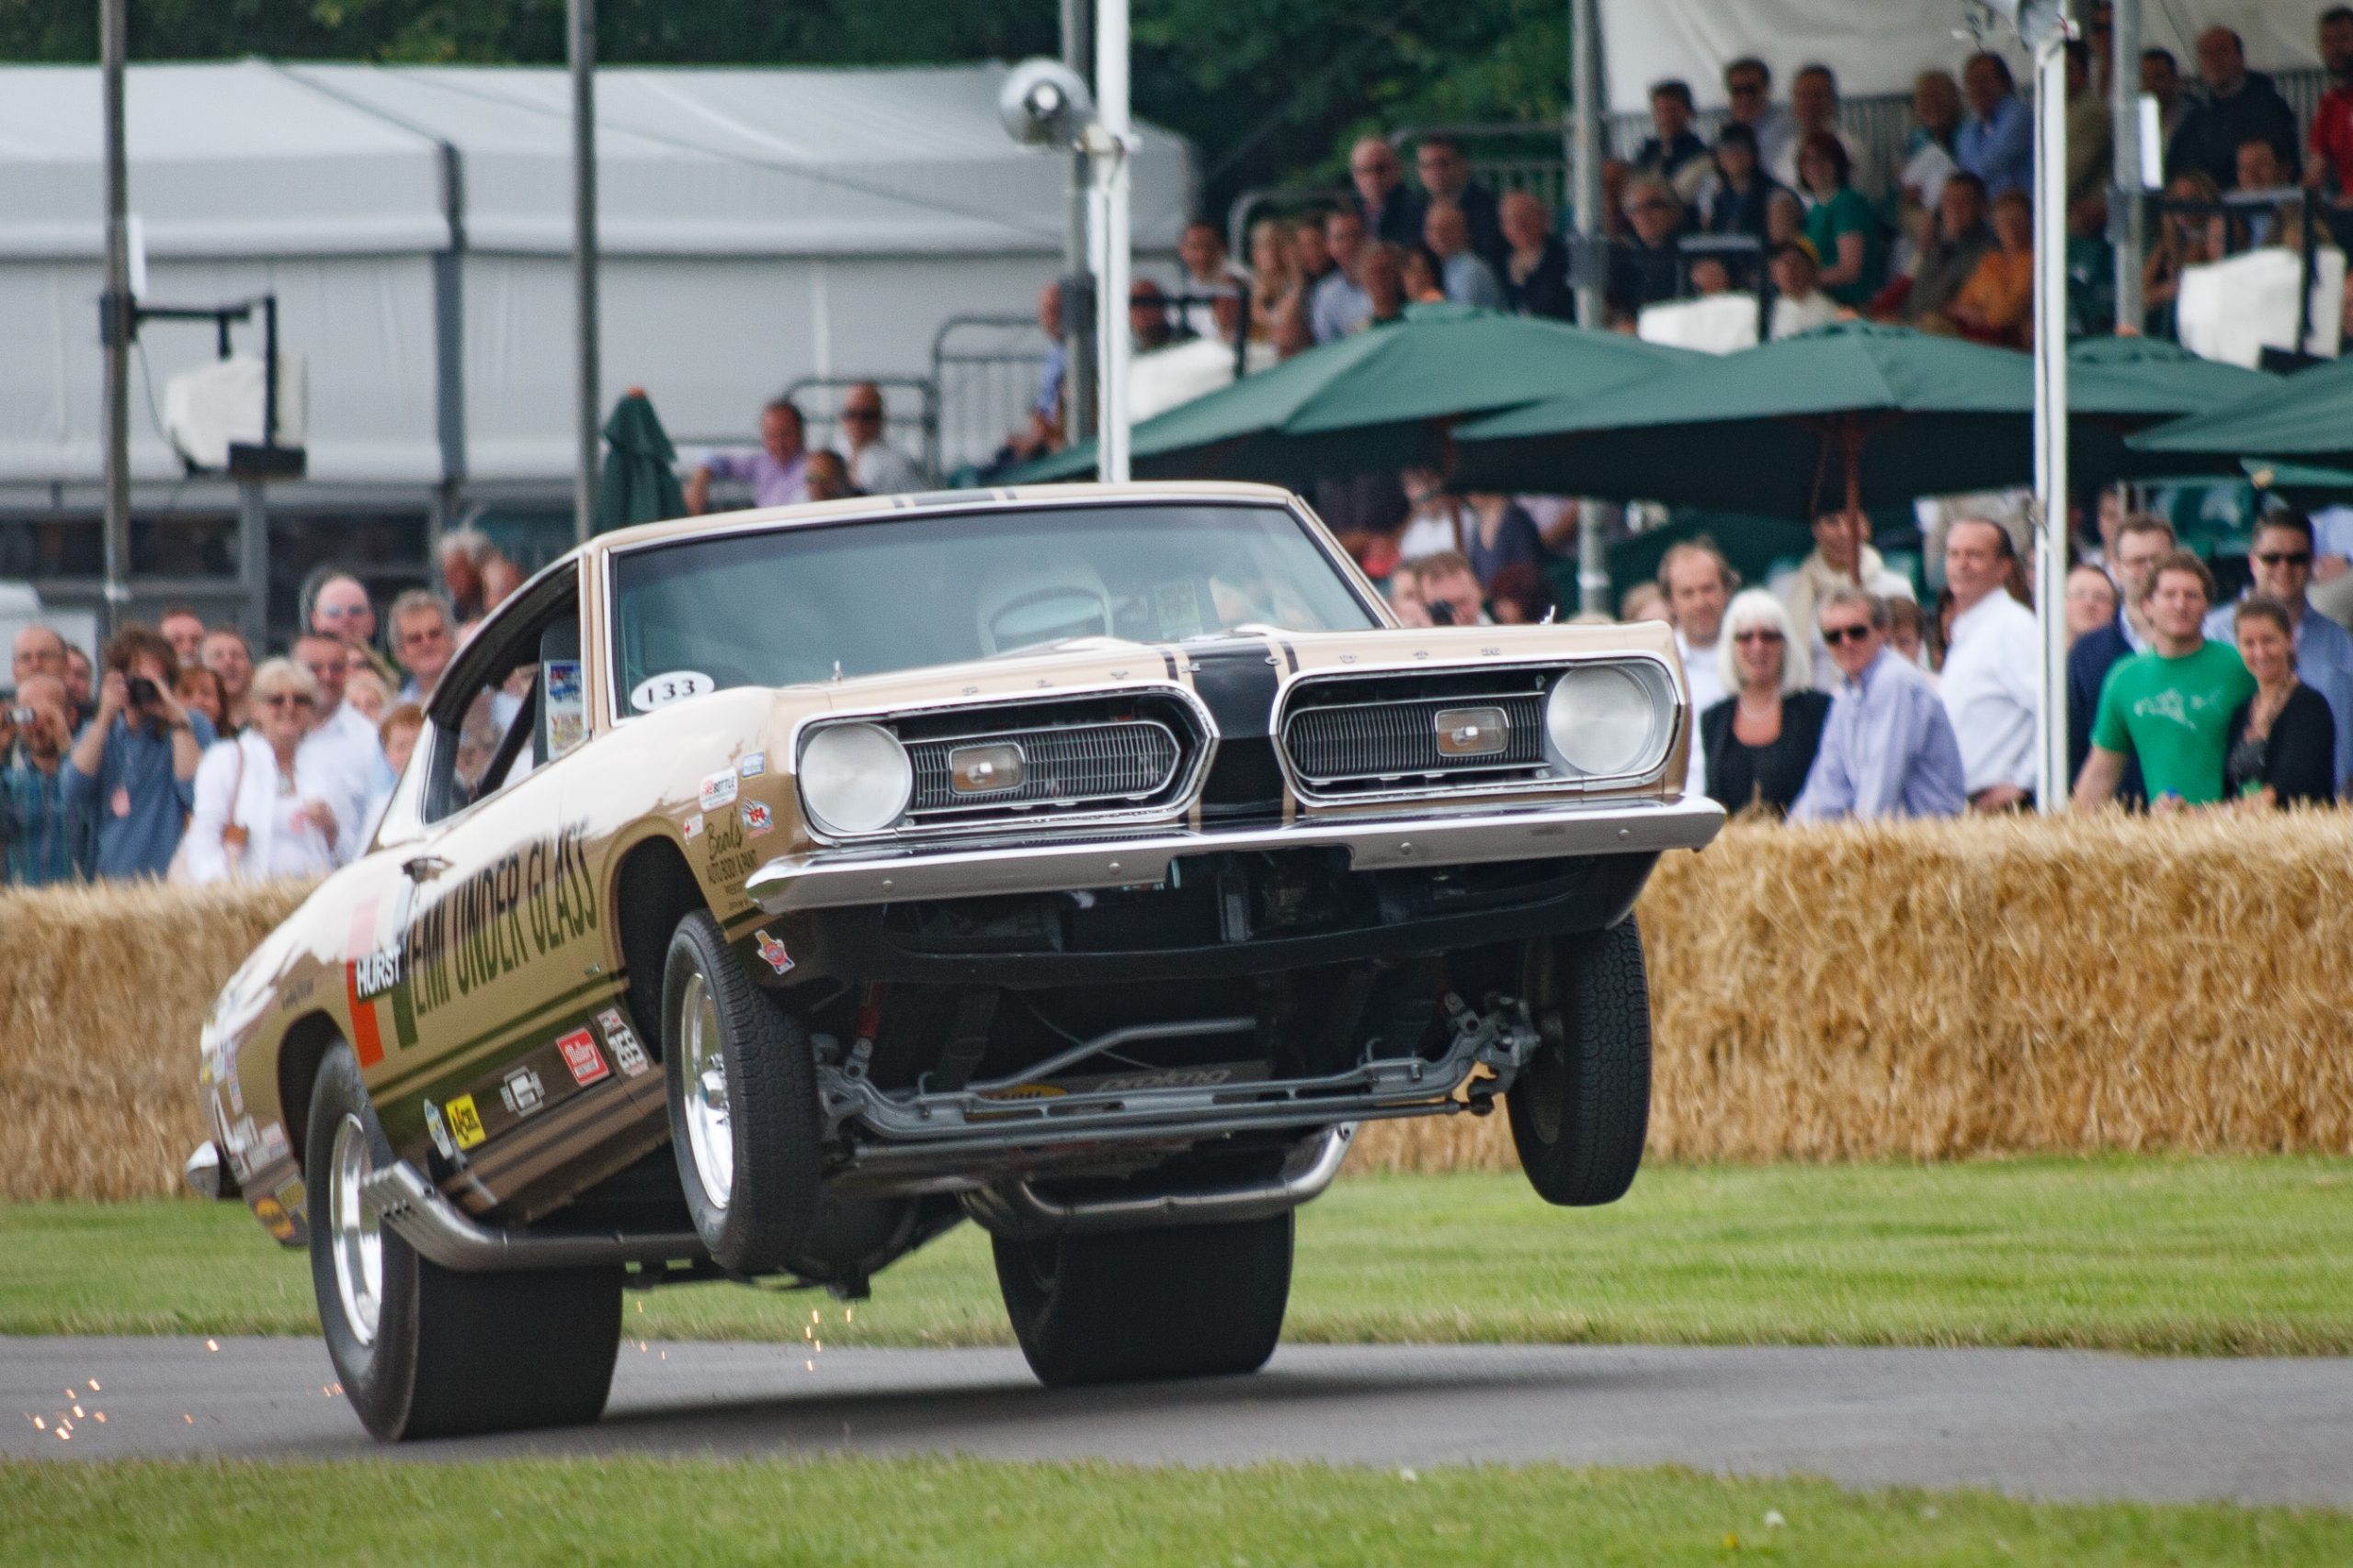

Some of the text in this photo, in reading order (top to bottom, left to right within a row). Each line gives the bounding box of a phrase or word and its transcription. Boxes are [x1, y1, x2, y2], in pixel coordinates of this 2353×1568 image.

[647, 679, 696, 704] 133
[452, 850, 529, 996] UNDER
[528, 817, 597, 955] GLASS
[355, 944, 402, 998] HURST
